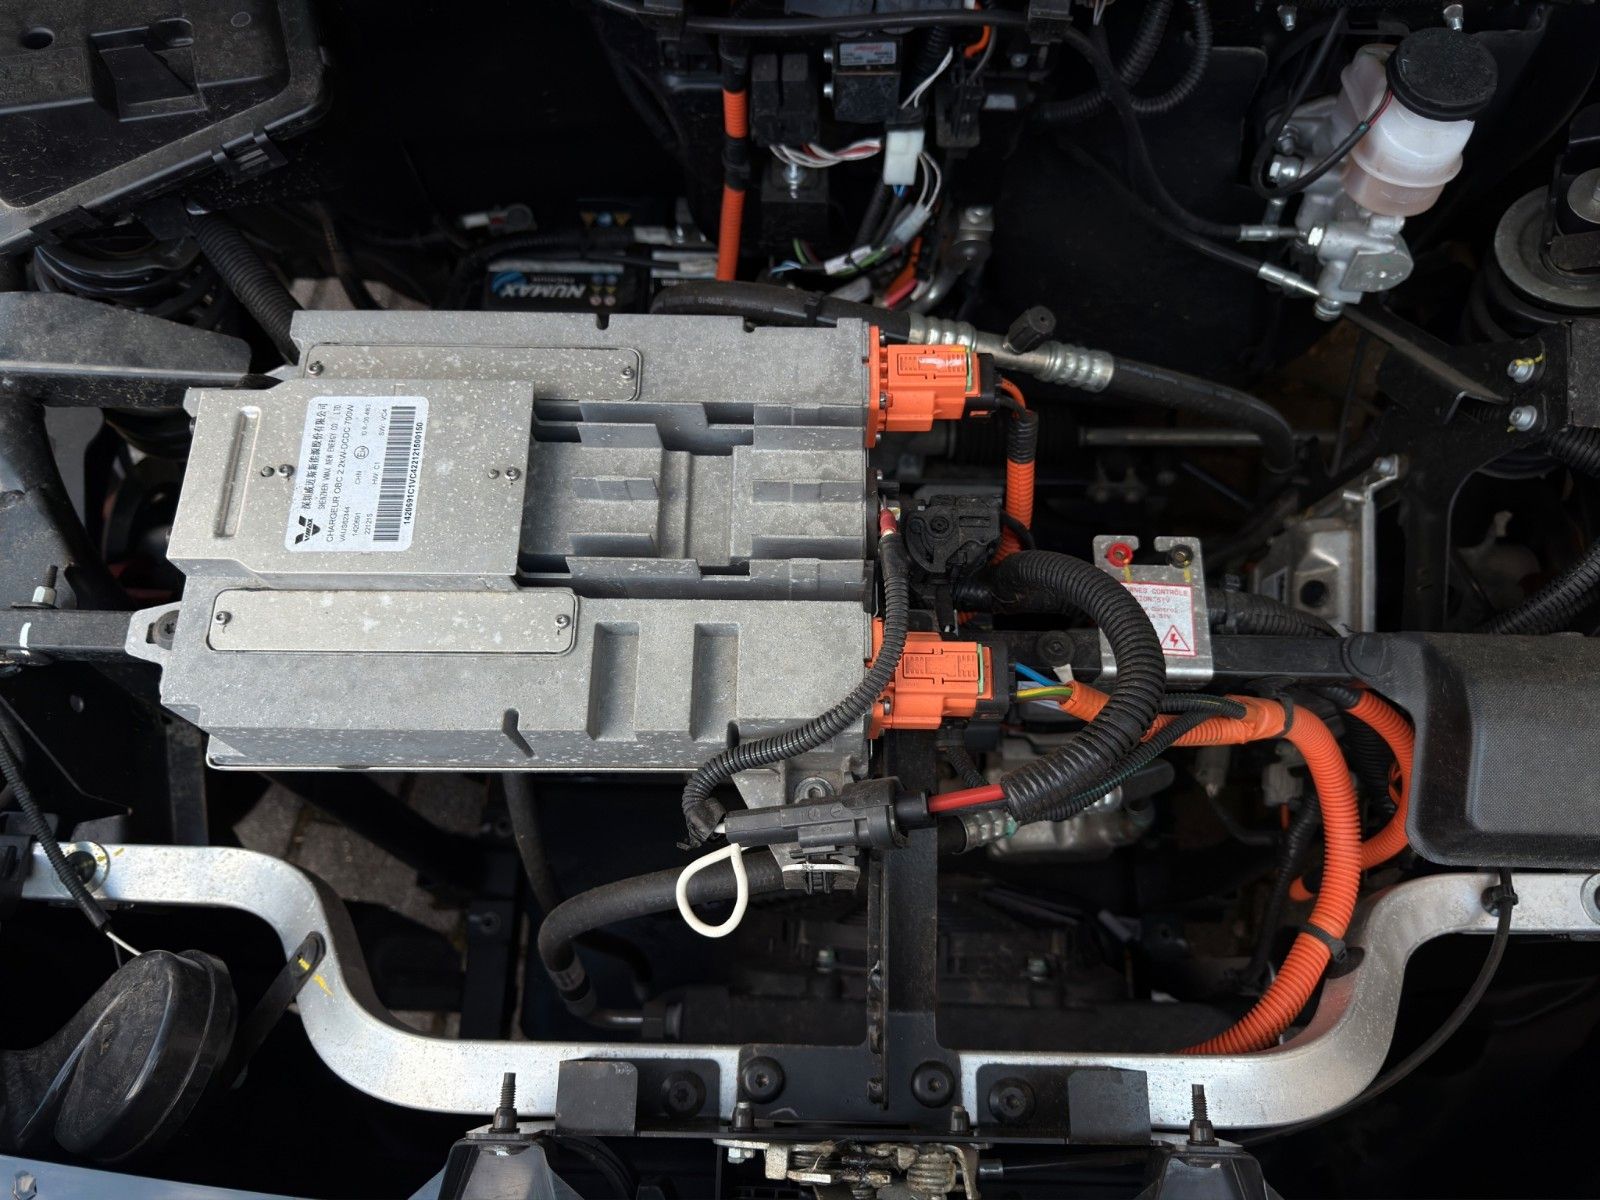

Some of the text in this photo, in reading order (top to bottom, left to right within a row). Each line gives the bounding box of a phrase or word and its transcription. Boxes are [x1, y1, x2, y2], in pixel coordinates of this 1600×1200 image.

[501, 283, 586, 299] NUMAX
[325, 455, 334, 465] NEW
[403, 422, 423, 524] 1420691C1VC422121500150
[325, 496, 340, 542] CHARGEUR
[333, 476, 343, 493] OBC
[352, 512, 361, 536] 1420691
